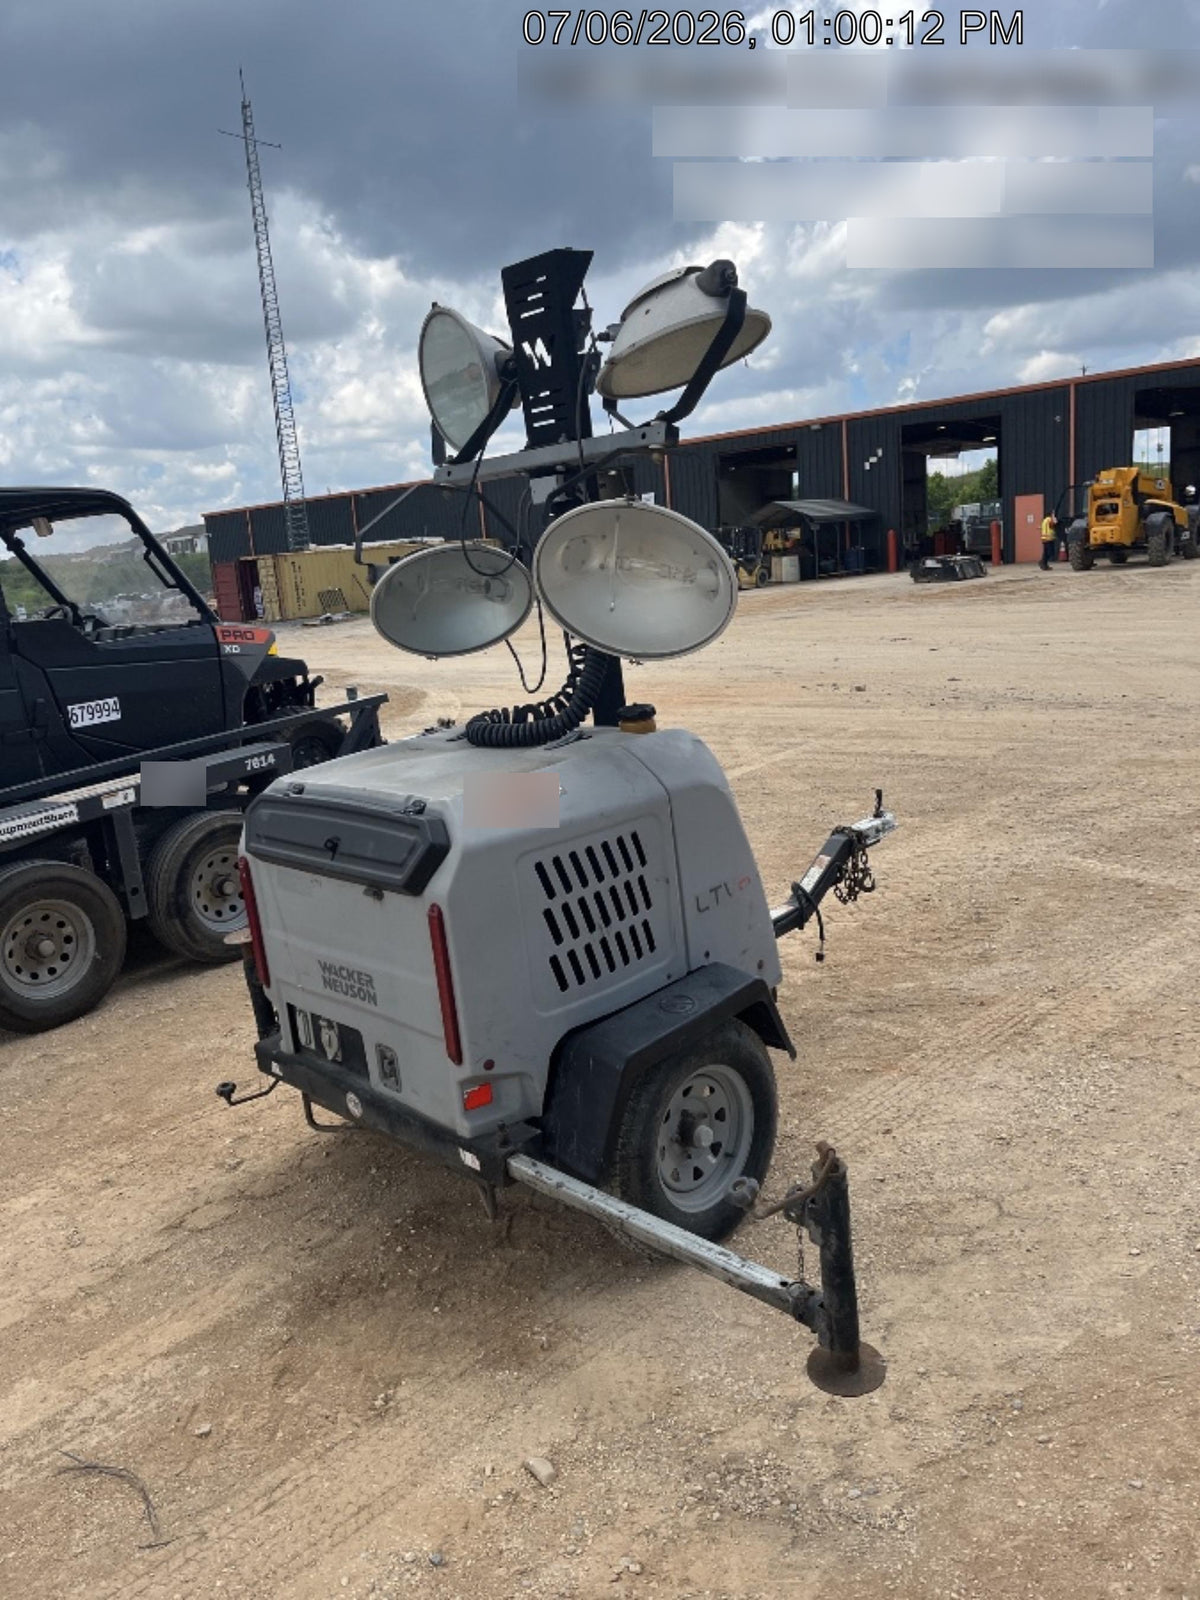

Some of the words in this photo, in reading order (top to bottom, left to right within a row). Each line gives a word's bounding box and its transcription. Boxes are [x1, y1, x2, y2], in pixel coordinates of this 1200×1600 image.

[221, 629, 255, 640] PRO
[223, 644, 241, 654] XD
[69, 699, 120, 724] 679994
[318, 959, 376, 991] WACKER
[321, 974, 378, 1007] NEUSON
